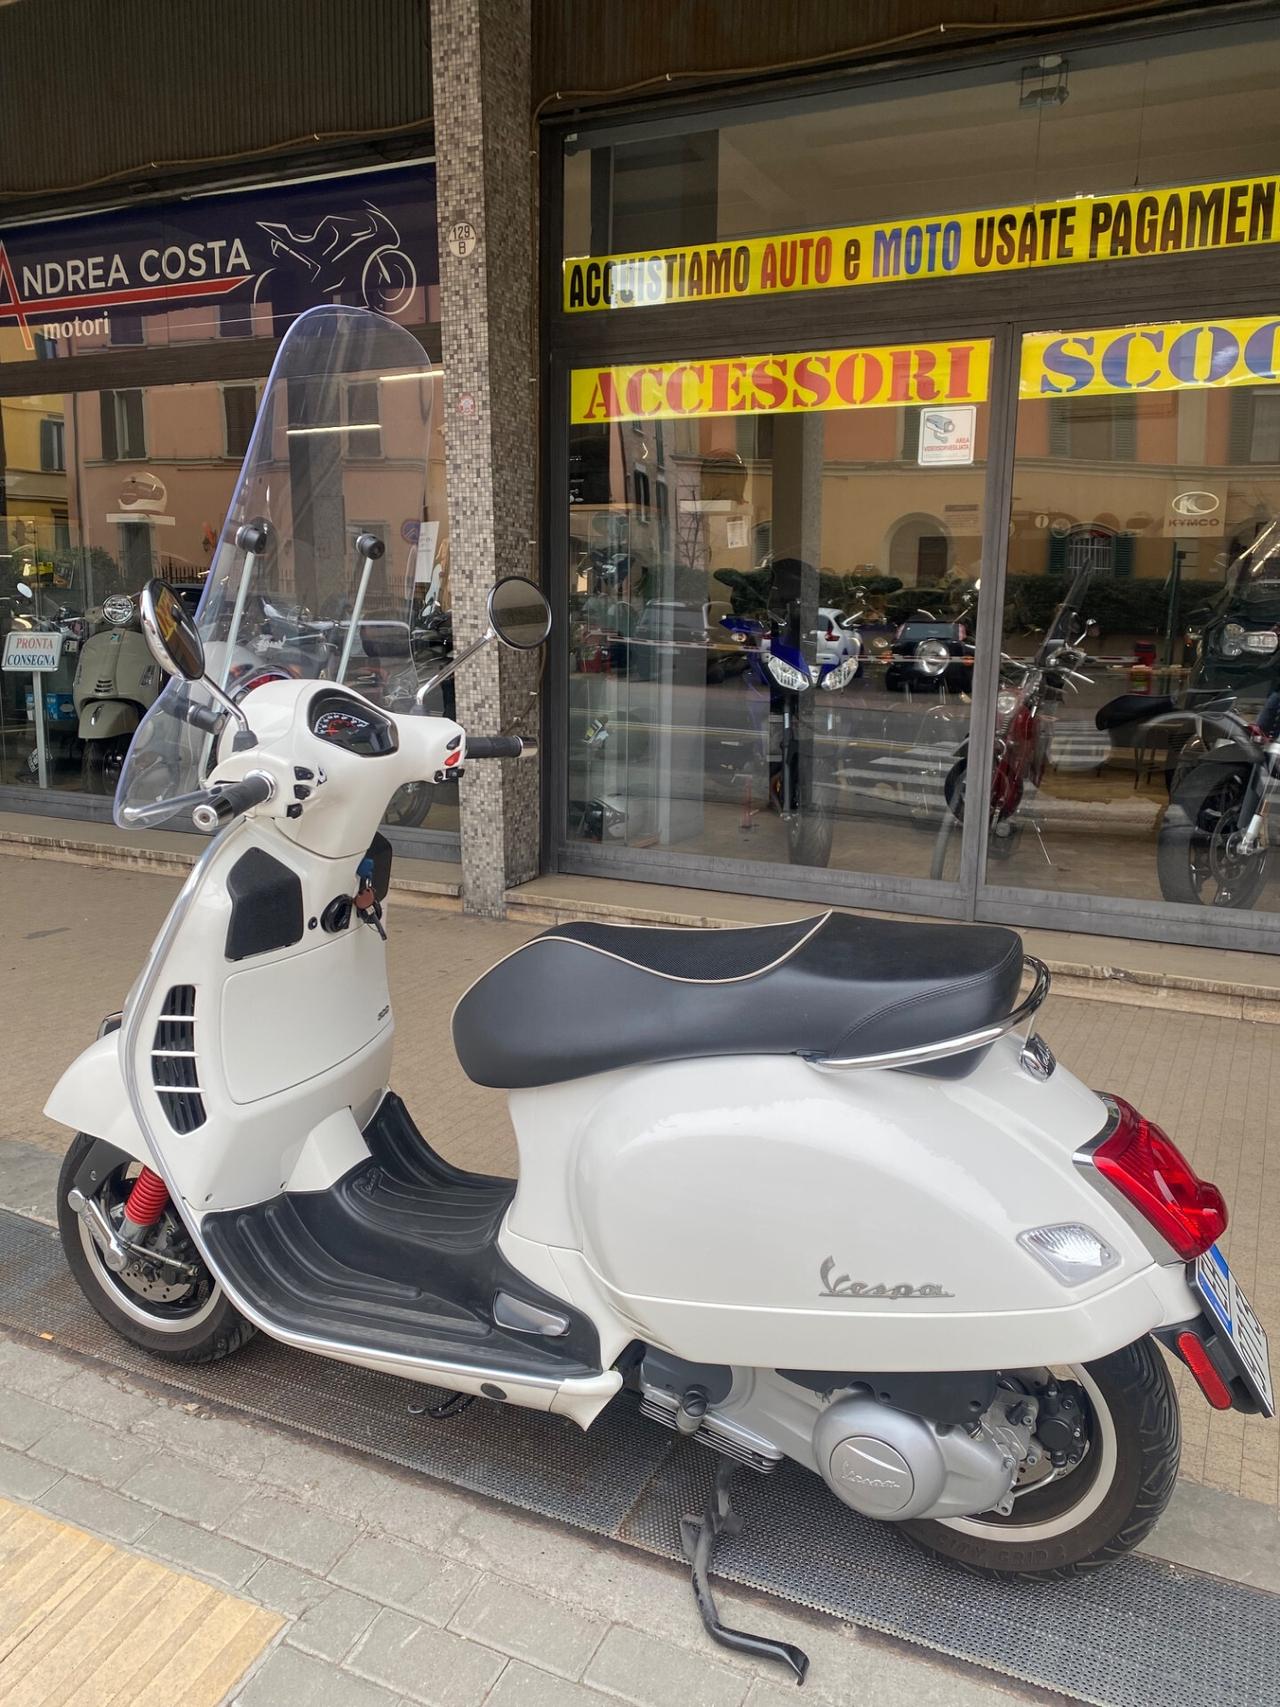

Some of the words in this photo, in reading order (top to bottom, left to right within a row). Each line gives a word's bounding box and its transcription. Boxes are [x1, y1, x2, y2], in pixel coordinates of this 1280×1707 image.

[453, 225, 471, 239] 129
[569, 246, 751, 308] ACQUISTIAMO
[761, 236, 833, 290] AUTO
[844, 238, 861, 281] e
[873, 220, 962, 279] MOTO
[974, 207, 1077, 268] USATE
[1089, 181, 1280, 259] PAGAMEN
[138, 238, 251, 283] COSTA
[43, 310, 109, 340] motori
[583, 346, 975, 420] ACCESSORI
[1168, 518, 1220, 528] KYMCO
[16, 638, 54, 650] PRONTA
[7, 654, 56, 666] CONSEGNA
[818, 1254, 956, 1300] Vespa
[839, 1460, 901, 1489] Vespa
